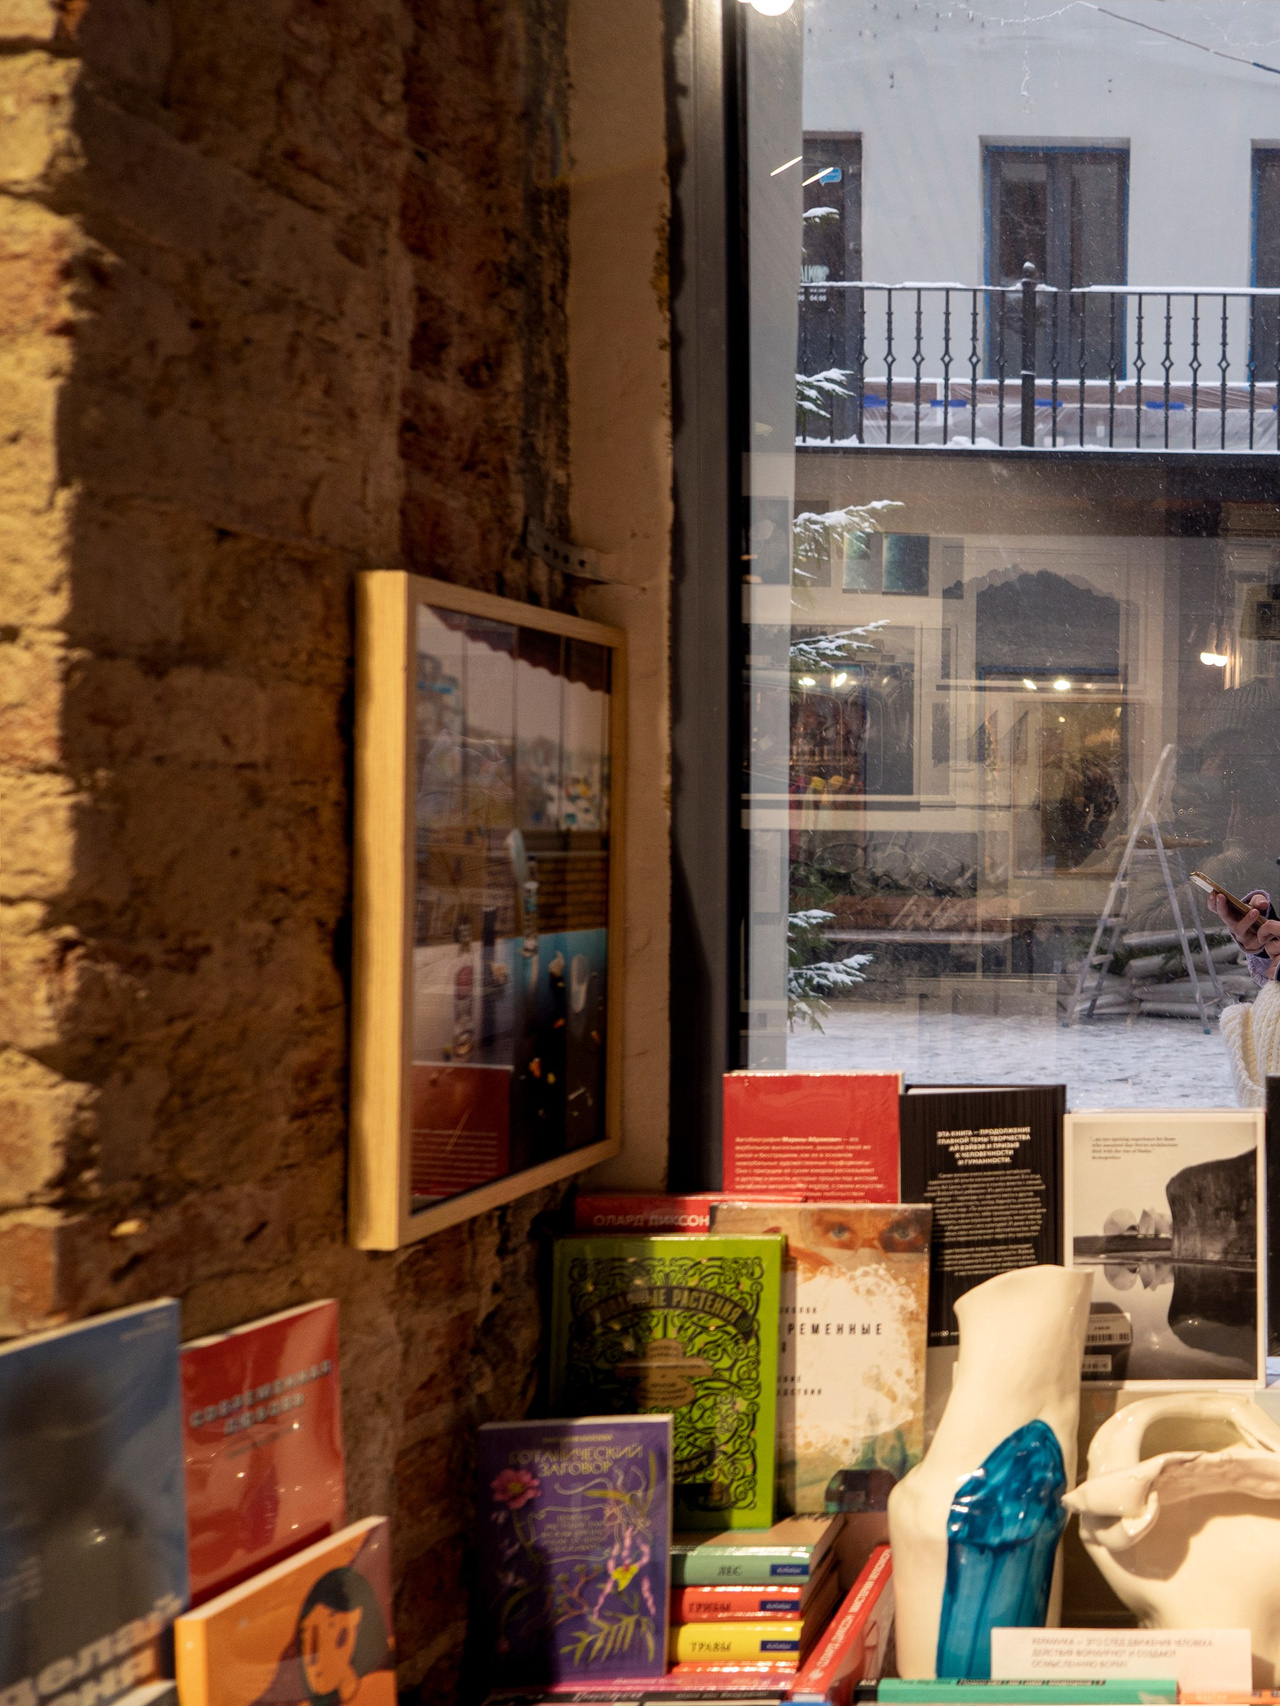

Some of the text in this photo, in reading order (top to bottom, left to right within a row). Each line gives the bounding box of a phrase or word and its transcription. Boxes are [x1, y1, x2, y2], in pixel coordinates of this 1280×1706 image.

[979, 1127, 1031, 1135] ПРОДОЛЖЕНИЕ
[937, 1136, 970, 1145] ГЛАВНОЙ
[961, 1150, 1014, 1158] ЧЕЛОВЕЧНОСТИ
[648, 1214, 710, 1226] ДИКСОН
[671, 1288, 742, 1323] РАСТЕНИЯ
[539, 1459, 614, 1478] ЗАГОВОР
[718, 1566, 743, 1577] ЛЕС
[688, 1601, 732, 1613] ГРИБЫ
[690, 1641, 732, 1653] ТРАВЫ
[1031, 1637, 1074, 1646] КЕРАМИКА
[1085, 1637, 1102, 1646] ЭТО
[1103, 1637, 1126, 1647] СЛЕД
[1127, 1638, 1172, 1647] ДВИЖЕНИЯ
[1031, 1649, 1074, 1658] ДЕЙСТВИЯ
